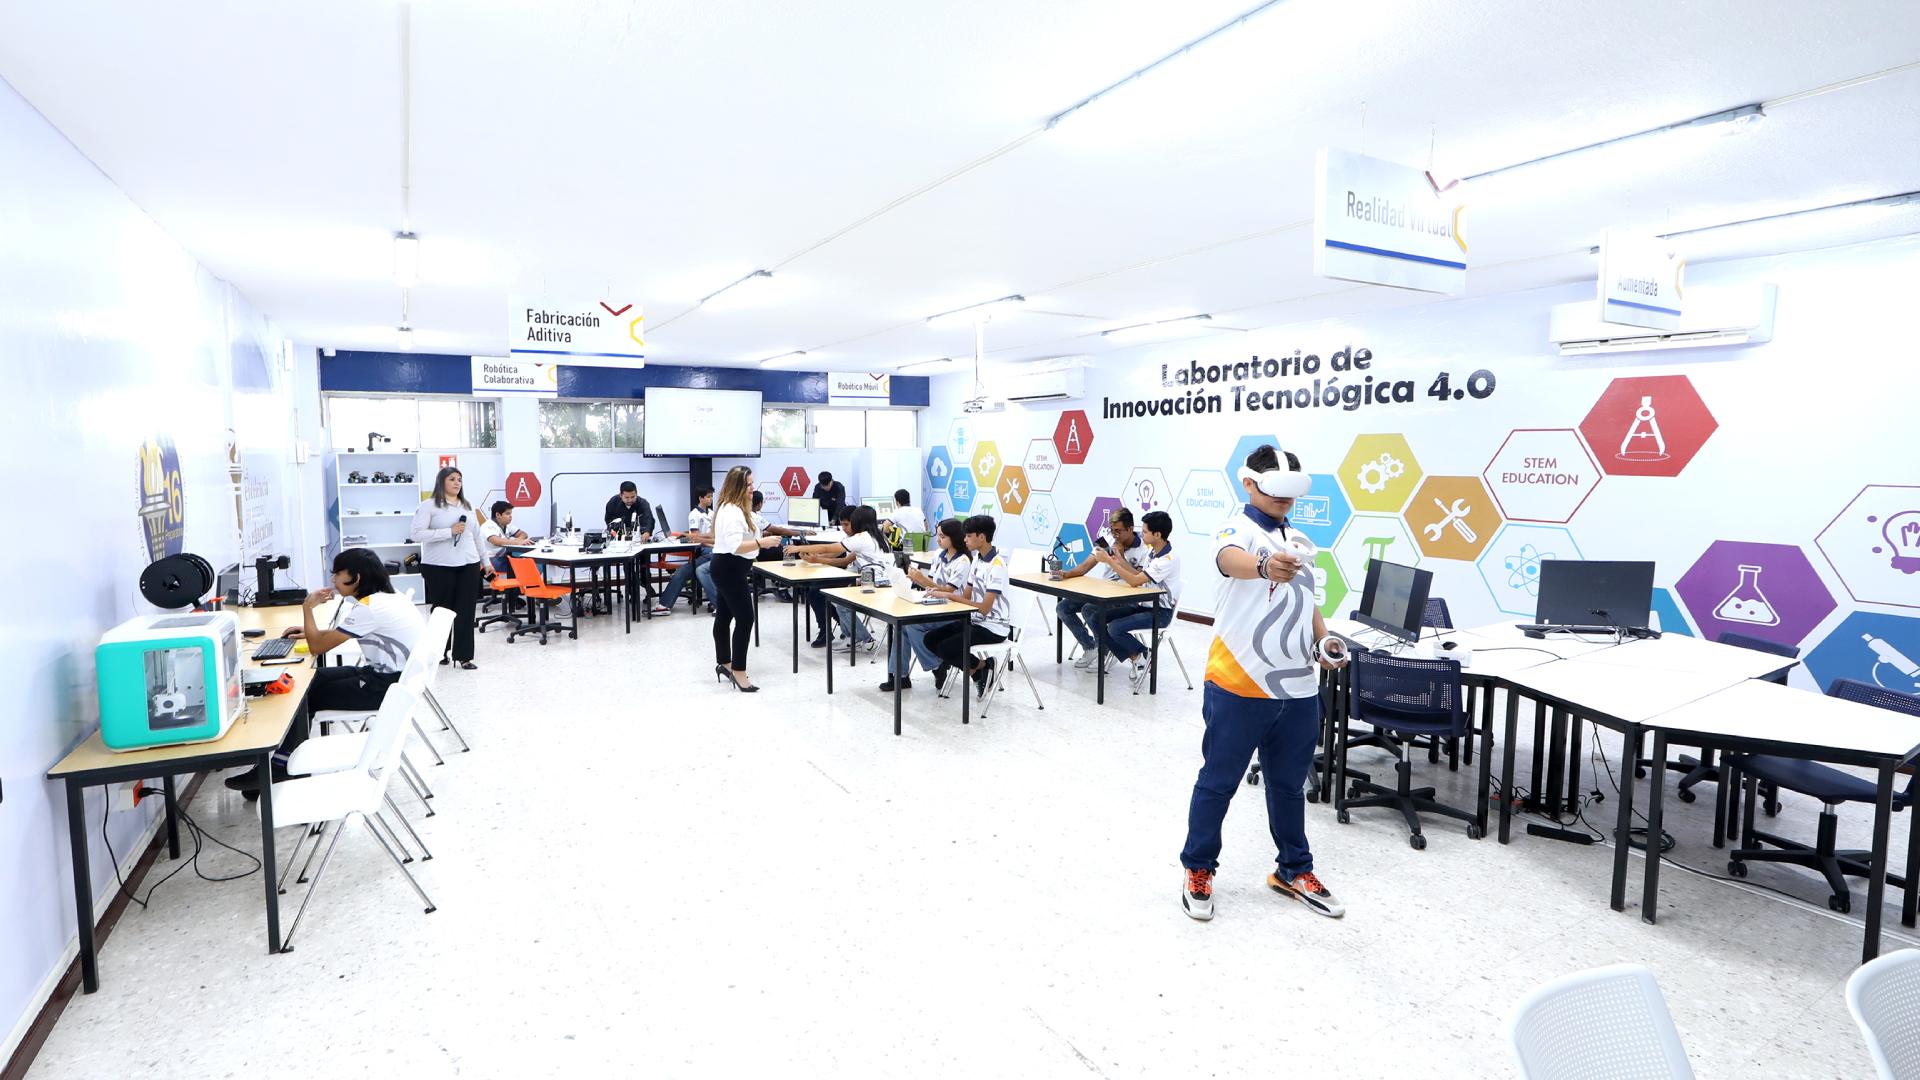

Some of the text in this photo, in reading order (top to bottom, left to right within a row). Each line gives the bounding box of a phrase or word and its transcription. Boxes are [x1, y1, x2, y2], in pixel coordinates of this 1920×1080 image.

[1346, 190, 1406, 229] Realidad
[526, 308, 601, 328] Fabricación
[526, 326, 572, 343] Aditiva
[483, 363, 518, 374] Robótica
[1161, 345, 1373, 388] Laboratorio de
[483, 374, 535, 386] Colaborativa
[837, 381, 863, 391] Robótica
[1102, 368, 1497, 419] Innovación Tecnológica 4.0
[1028, 463, 1056, 472] EDUCATION
[1523, 457, 1558, 469] STEM
[1501, 472, 1579, 486] EDUCATION
[163, 470, 183, 525] 16
[1196, 488, 1215, 497] STEM
[1185, 498, 1226, 509] EDUCATION
